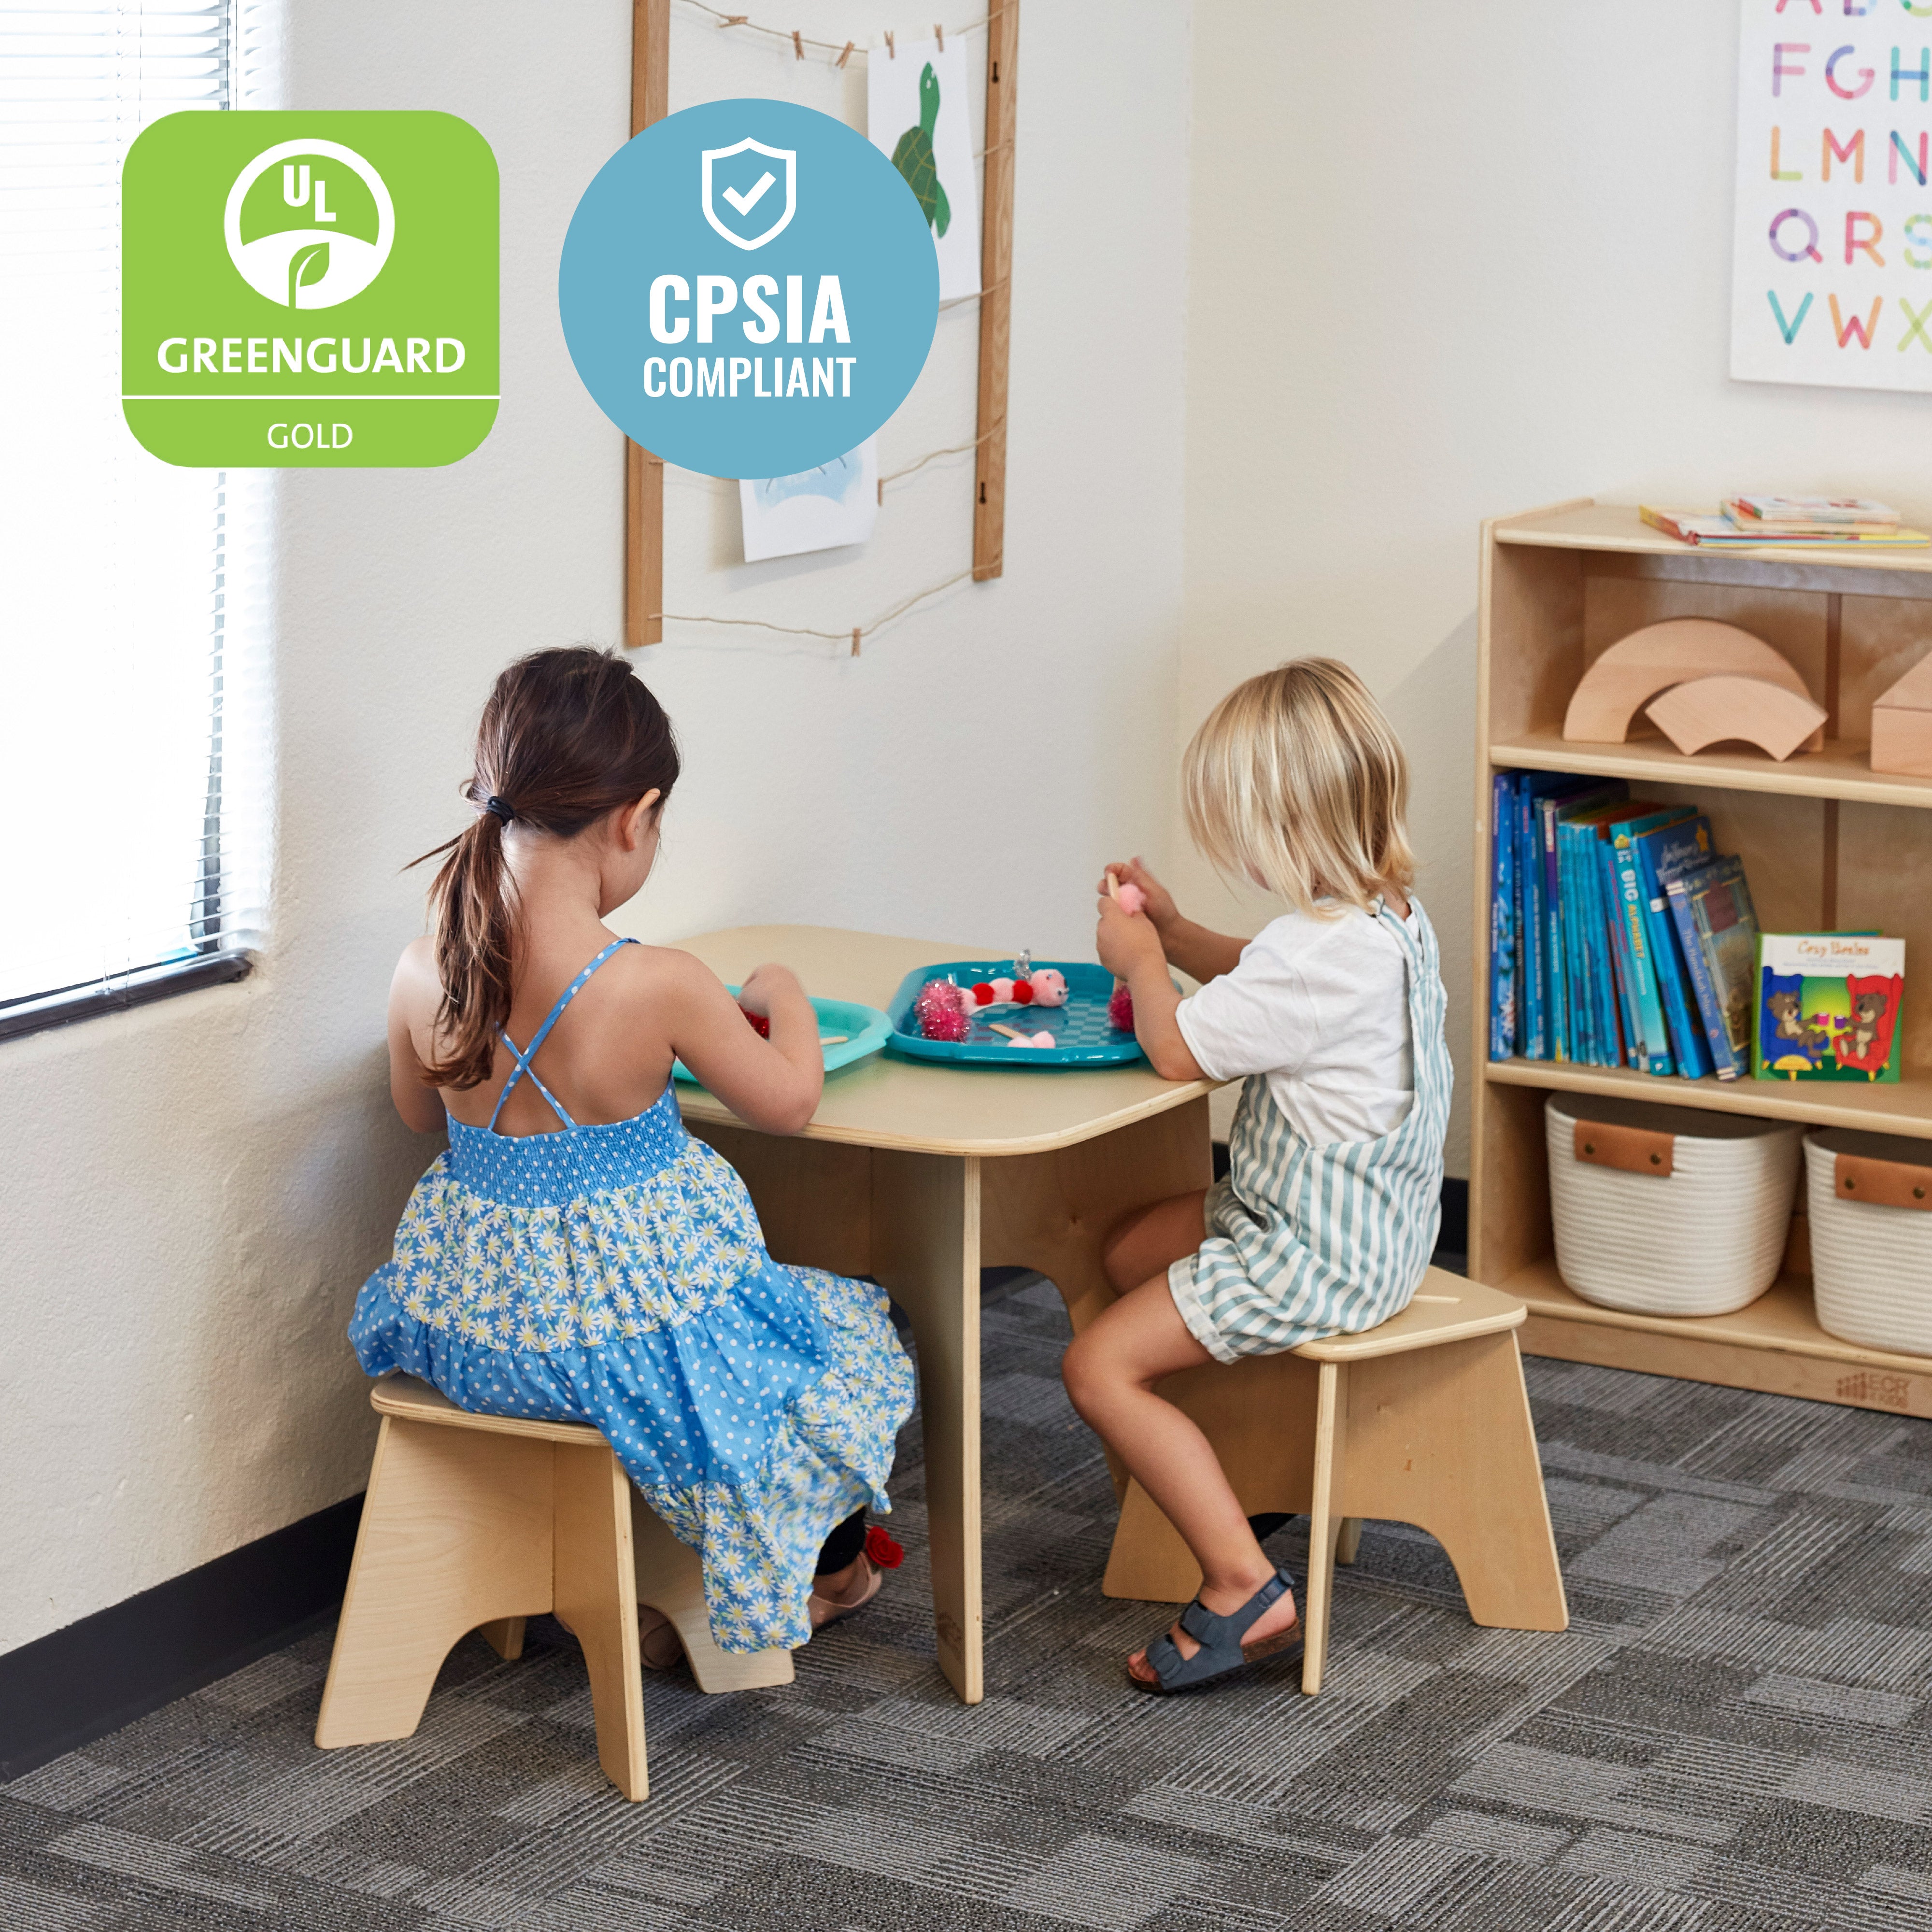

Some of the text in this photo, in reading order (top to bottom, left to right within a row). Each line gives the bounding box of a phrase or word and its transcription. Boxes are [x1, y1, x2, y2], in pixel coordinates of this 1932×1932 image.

[1772, 43, 1930, 102] F G H
[1770, 126, 1929, 186] L M N
[1769, 209, 1932, 270] Q R S
[1767, 290, 1932, 353] V W X
[1621, 869, 1639, 902] BIG
[1628, 904, 1645, 959] ALPHABET
